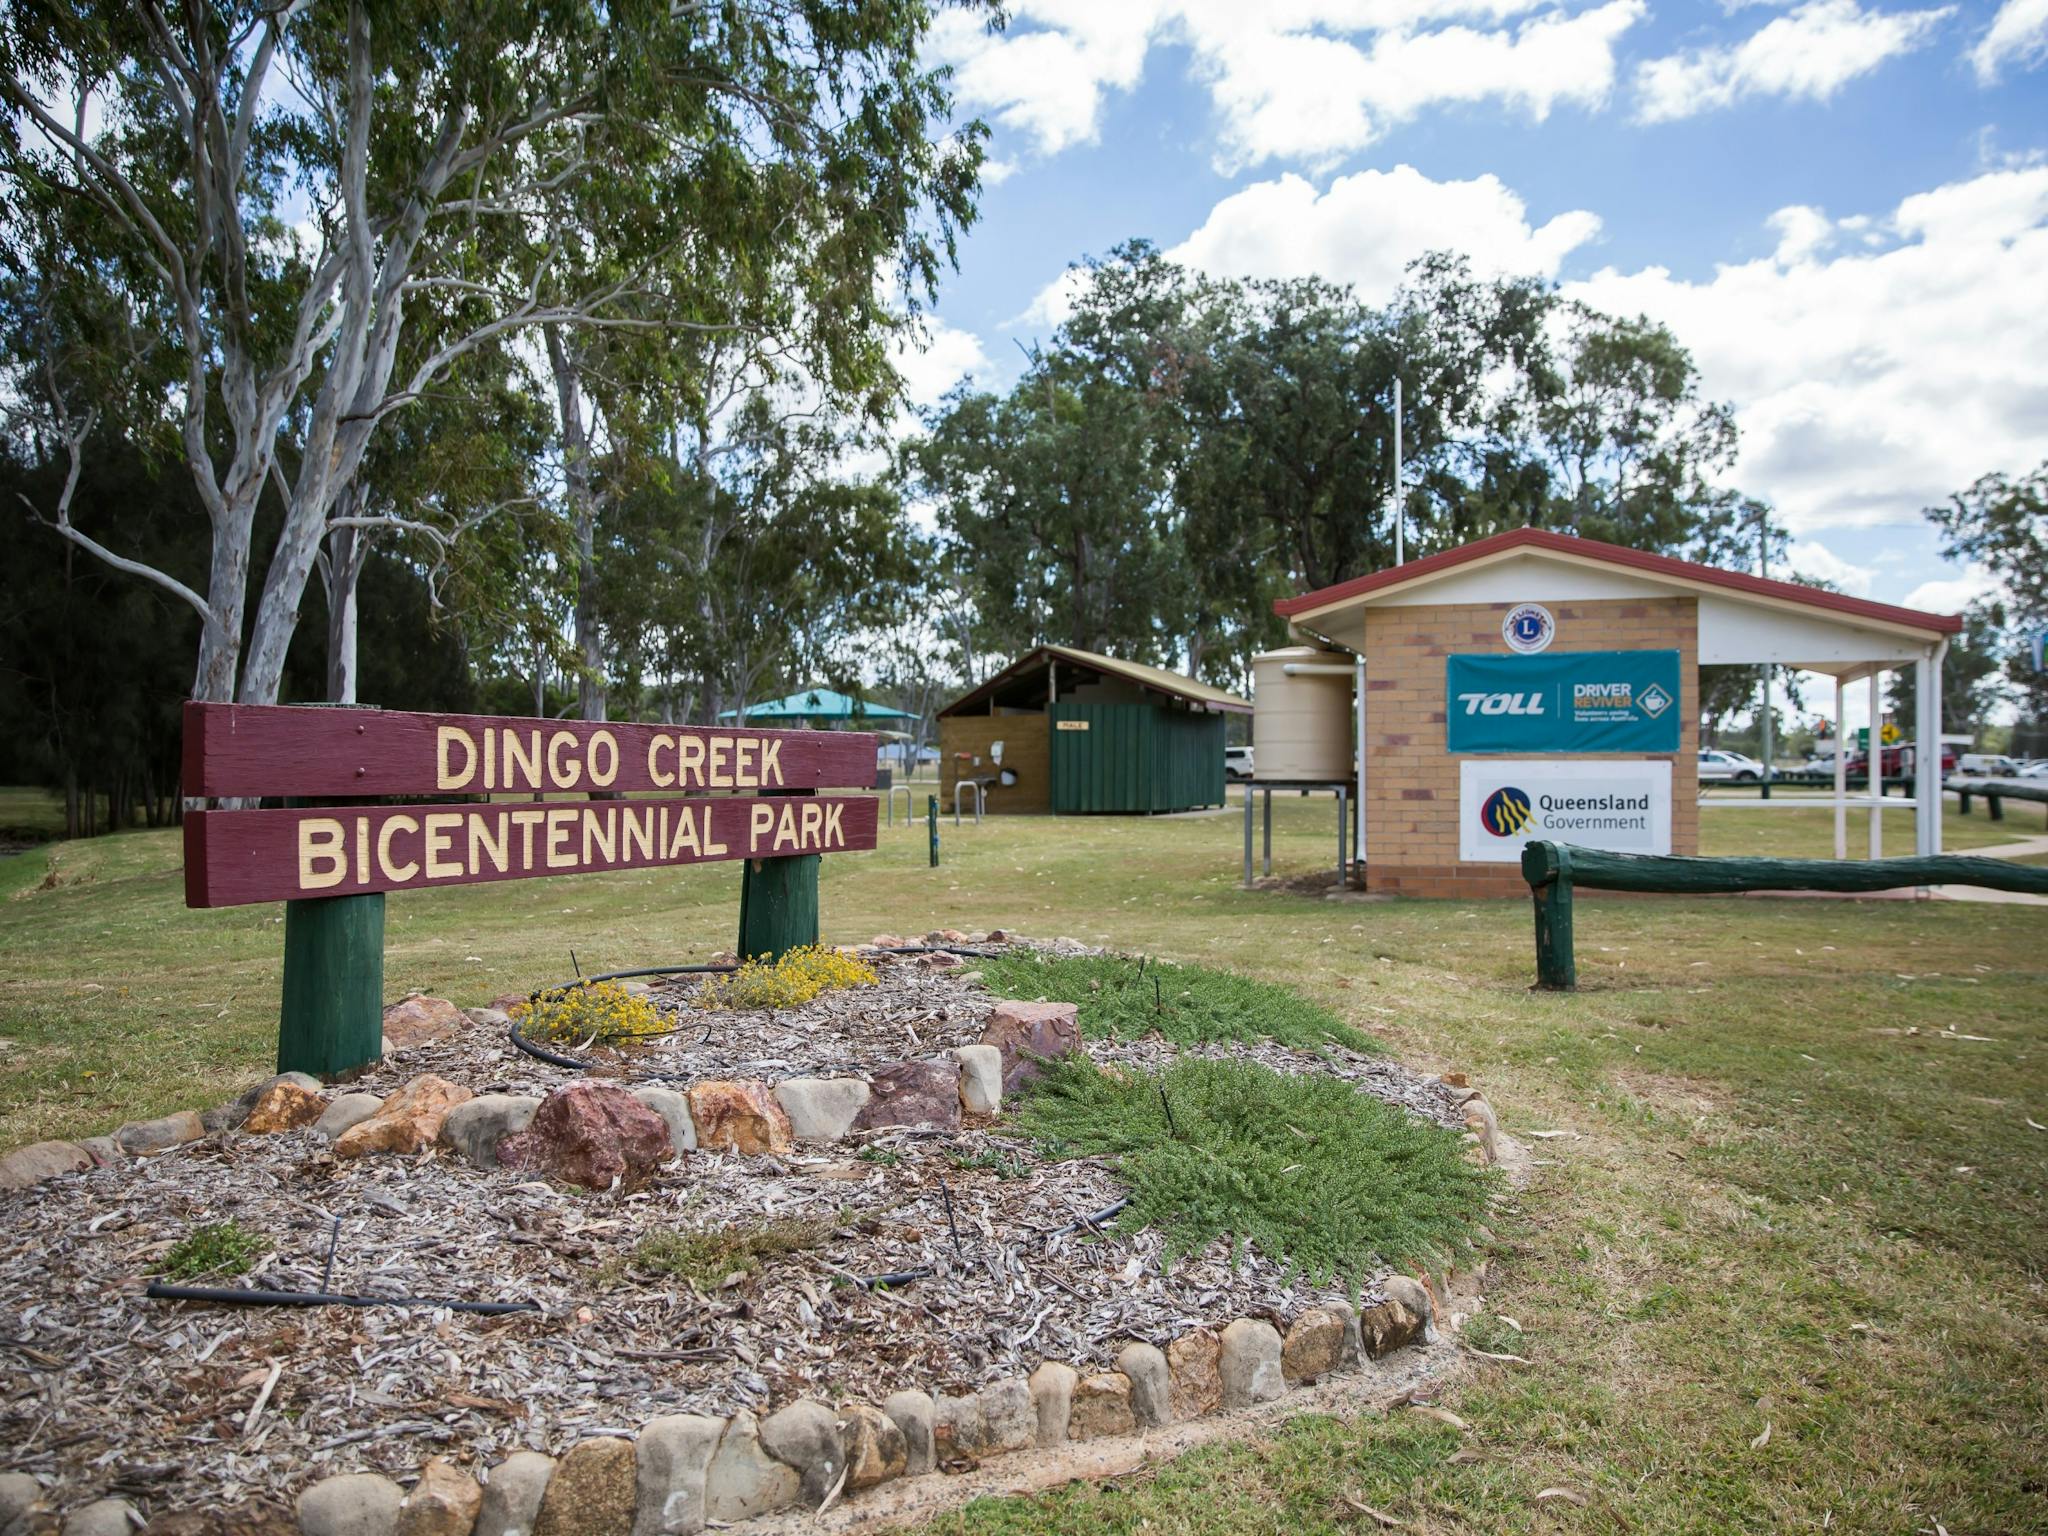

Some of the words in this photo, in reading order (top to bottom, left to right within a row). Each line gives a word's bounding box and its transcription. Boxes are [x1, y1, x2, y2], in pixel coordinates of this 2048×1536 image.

[1523, 619, 1534, 635] L
[1574, 683, 1631, 697] DRIVER
[1458, 692, 1545, 716] TOLL
[1574, 697, 1632, 708] REVIVER
[437, 725, 619, 791] DINGO
[648, 733, 784, 789] CREEK
[1540, 794, 1649, 812] Queensland
[1543, 815, 1646, 830] Government
[298, 804, 728, 890] BICENTENNIAL
[749, 801, 846, 854] PARK
